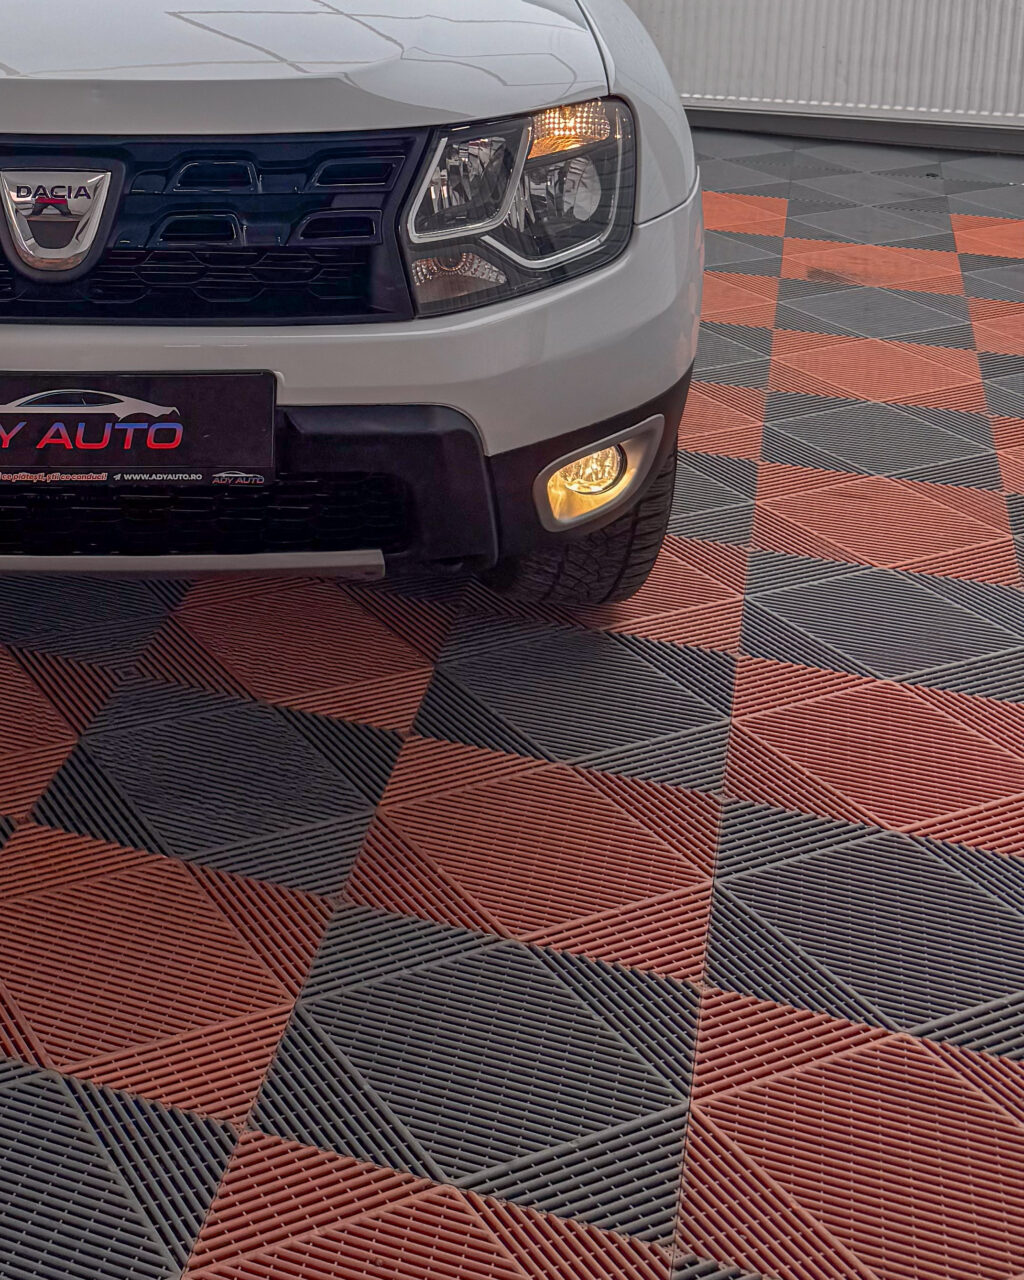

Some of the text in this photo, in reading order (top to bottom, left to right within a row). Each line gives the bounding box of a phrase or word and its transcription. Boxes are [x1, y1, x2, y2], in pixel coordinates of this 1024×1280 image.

[16, 185, 91, 200] DACIA
[36, 422, 184, 450] AUTO
[235, 476, 265, 484] AUTO
